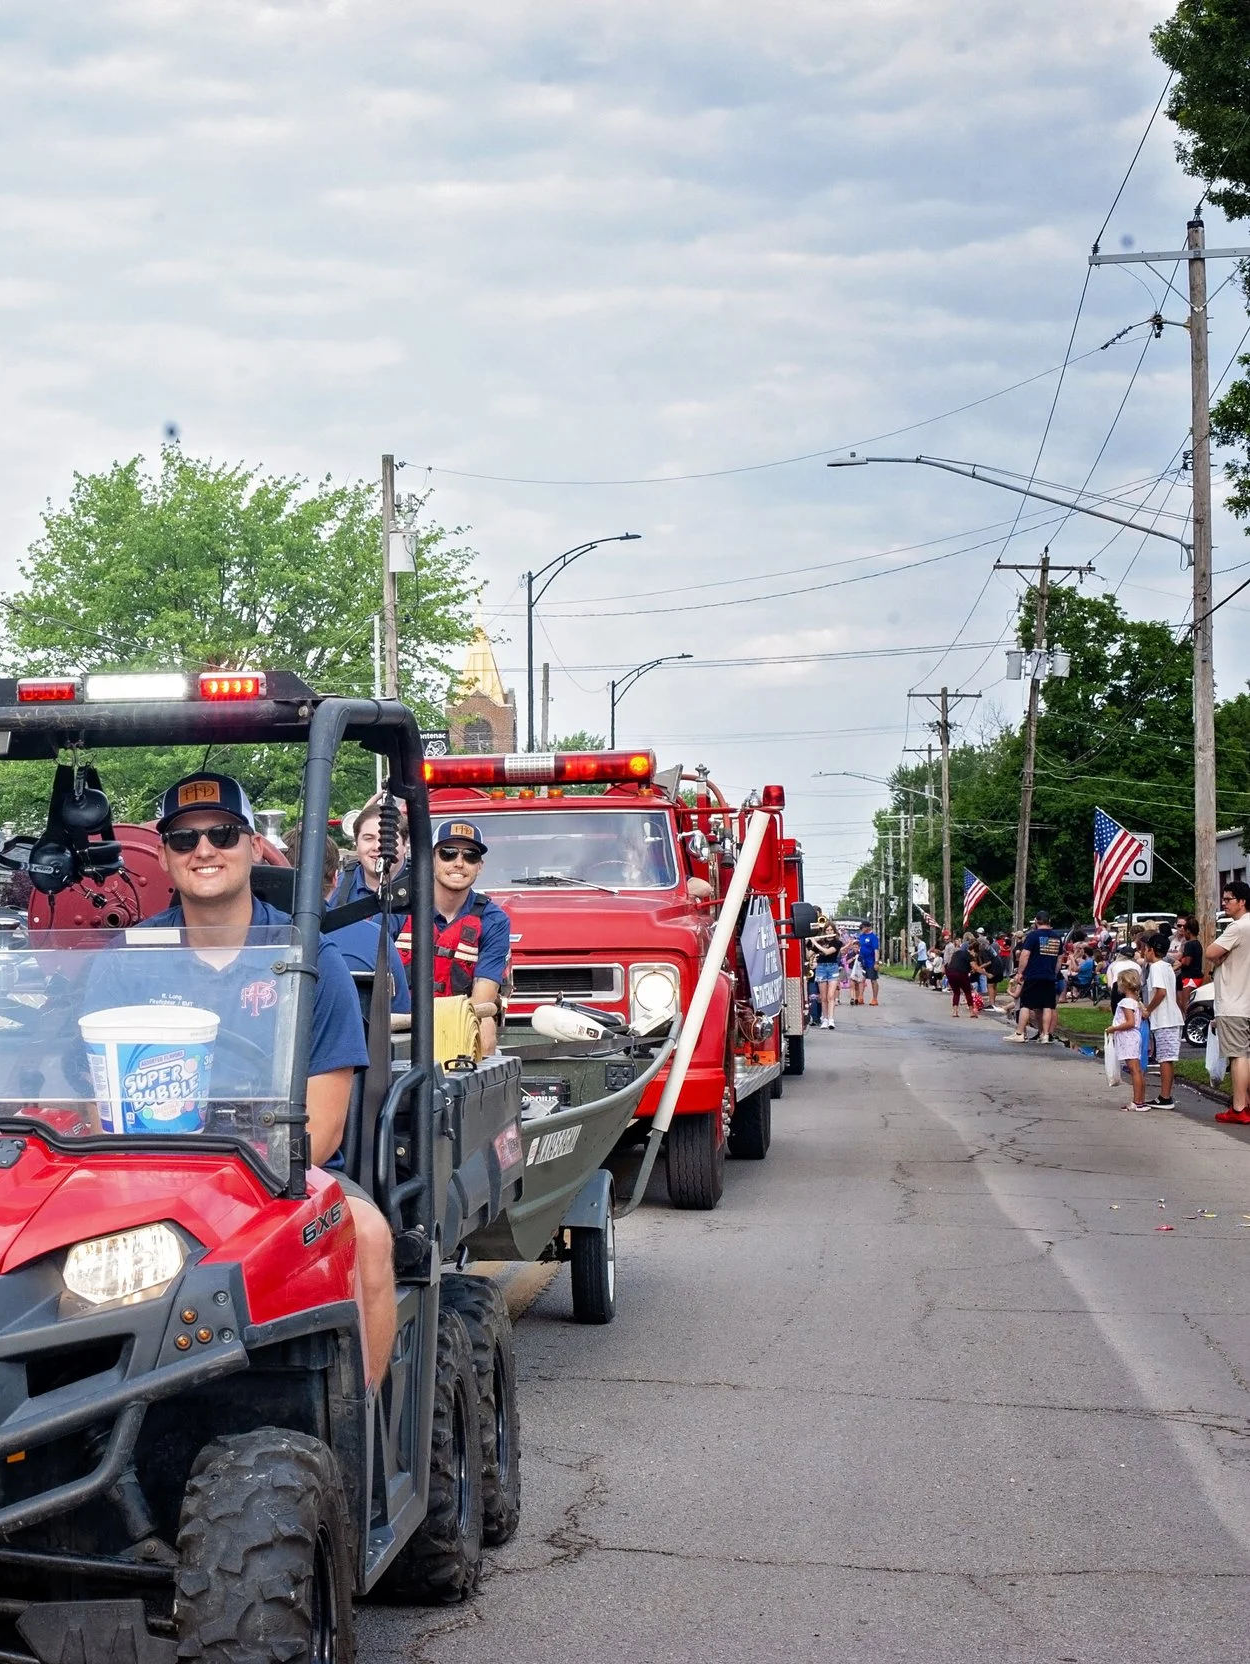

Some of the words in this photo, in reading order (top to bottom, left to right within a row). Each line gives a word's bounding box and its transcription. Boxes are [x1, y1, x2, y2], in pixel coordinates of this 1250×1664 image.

[123, 1064, 182, 1096] SUPER
[131, 1073, 199, 1112] BUBBLE
[303, 1201, 342, 1246] 6X6
